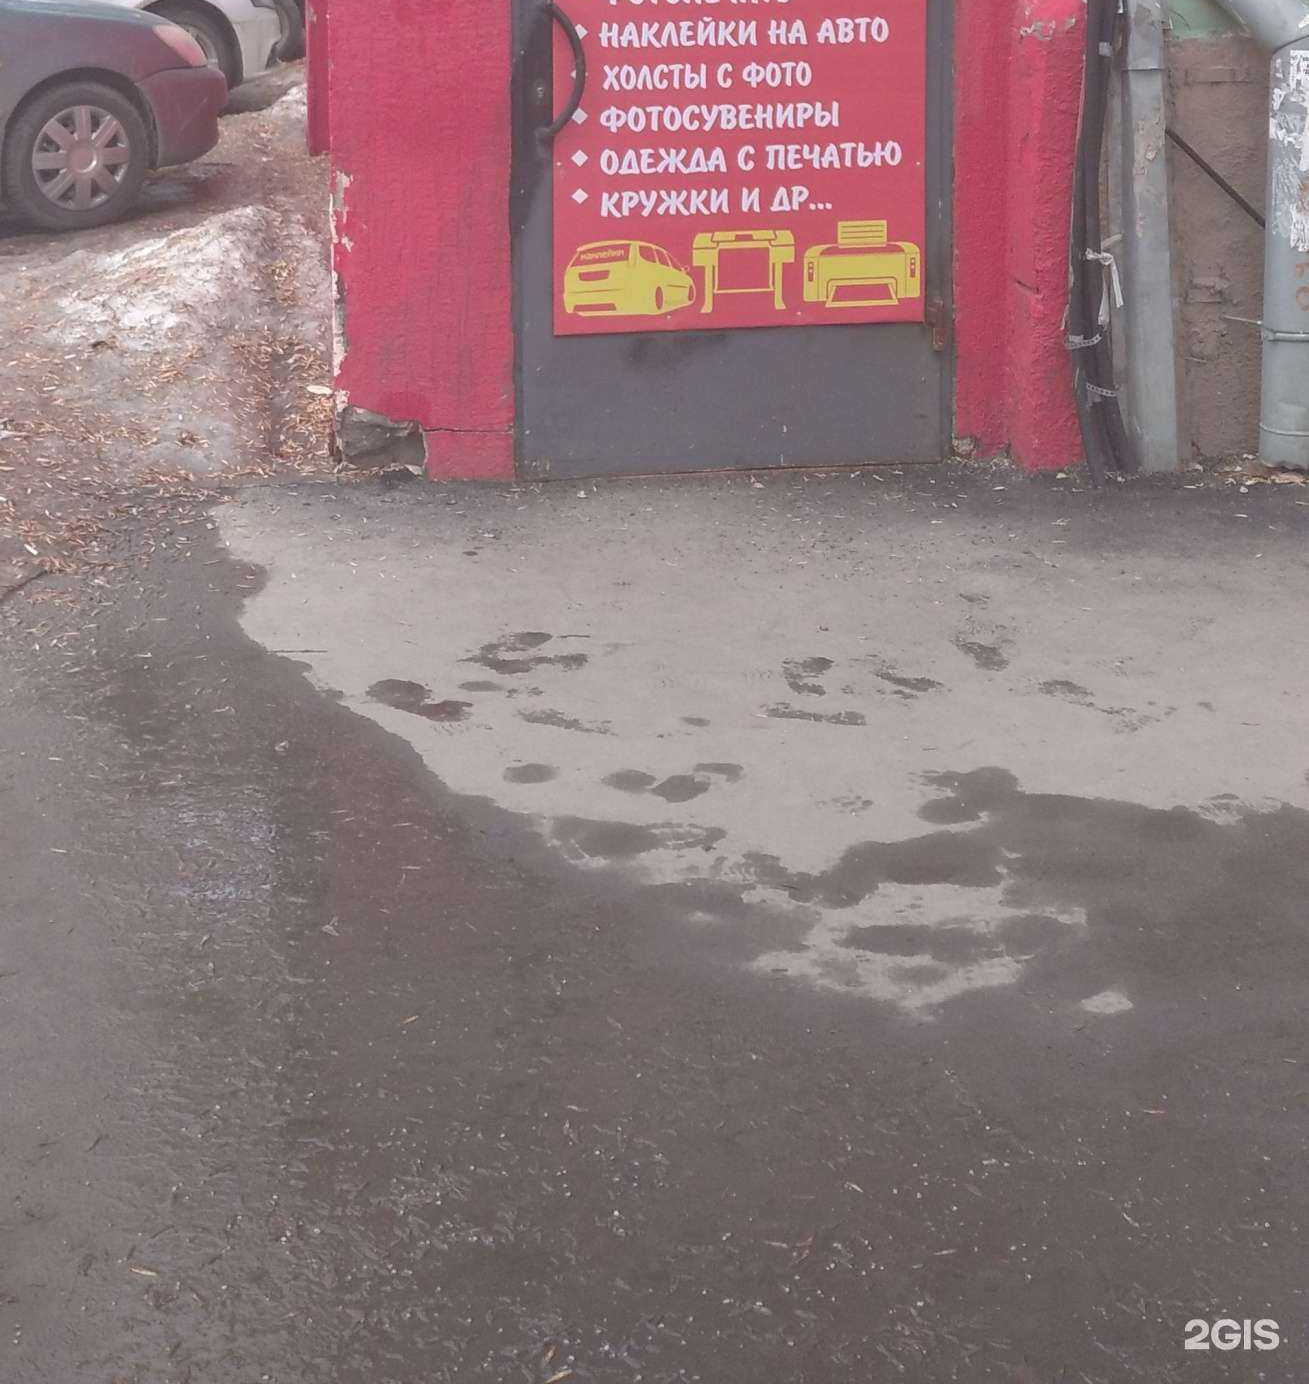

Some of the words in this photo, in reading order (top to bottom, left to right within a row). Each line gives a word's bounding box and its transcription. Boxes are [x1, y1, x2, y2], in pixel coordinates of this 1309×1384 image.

[599, 16, 757, 48] НАКЛЕЙКИ
[768, 19, 808, 46] НА
[817, 16, 890, 45] АВТО
[603, 63, 707, 91] ХОЛСТЫ
[716, 63, 733, 89] С
[742, 61, 813, 89] ФОТО
[599, 101, 840, 134] ФОТОСУВЕНИРЫ
[600, 146, 727, 176] ОДЕЖДА
[737, 145, 756, 171] С
[765, 140, 903, 171] ПЕЧАТЬЮ
[600, 187, 730, 218] КРУЖКИ
[741, 187, 761, 214] И
[769, 186, 833, 213] ДР...
